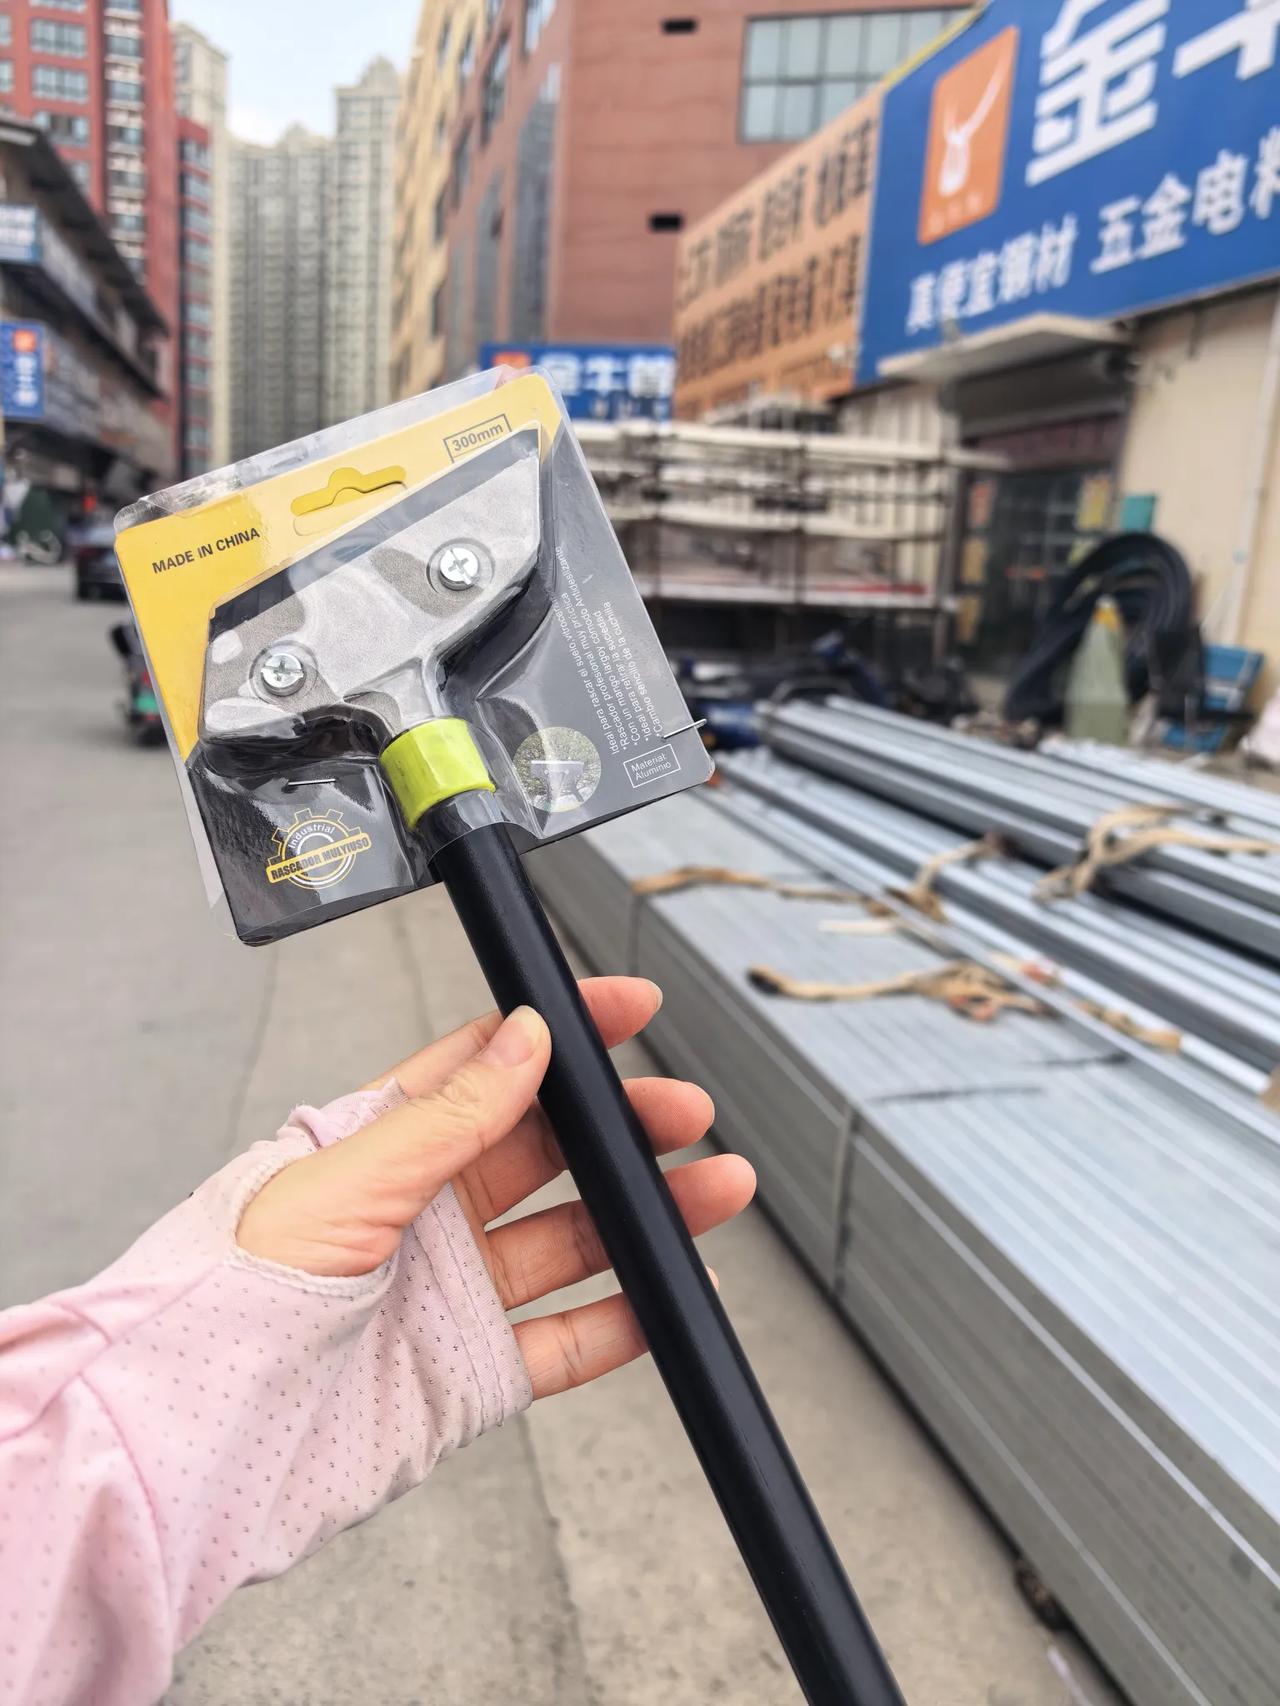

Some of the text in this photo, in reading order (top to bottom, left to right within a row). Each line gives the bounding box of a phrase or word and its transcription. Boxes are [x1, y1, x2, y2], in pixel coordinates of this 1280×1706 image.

[452, 424, 504, 451] 300mm
[152, 527, 260, 574] MADE IN CHINA
[593, 610, 615, 651] suciedad
[602, 601, 622, 636] cuchilla
[577, 629, 591, 649] muy
[616, 637, 626, 646] la
[610, 652, 620, 661] la
[621, 647, 632, 660] de
[578, 667, 588, 676] el
[584, 650, 612, 701] profesional
[627, 661, 646, 695] sencillo
[583, 677, 600, 707] rascar
[608, 674, 627, 706] mango
[628, 690, 642, 711] para
[596, 708, 611, 729] para
[621, 707, 631, 720] un
[604, 730, 619, 753] Ideal
[635, 761, 671, 780] Aluminio
[288, 824, 336, 849] Industrial
[270, 854, 322, 880] RASCADOR
